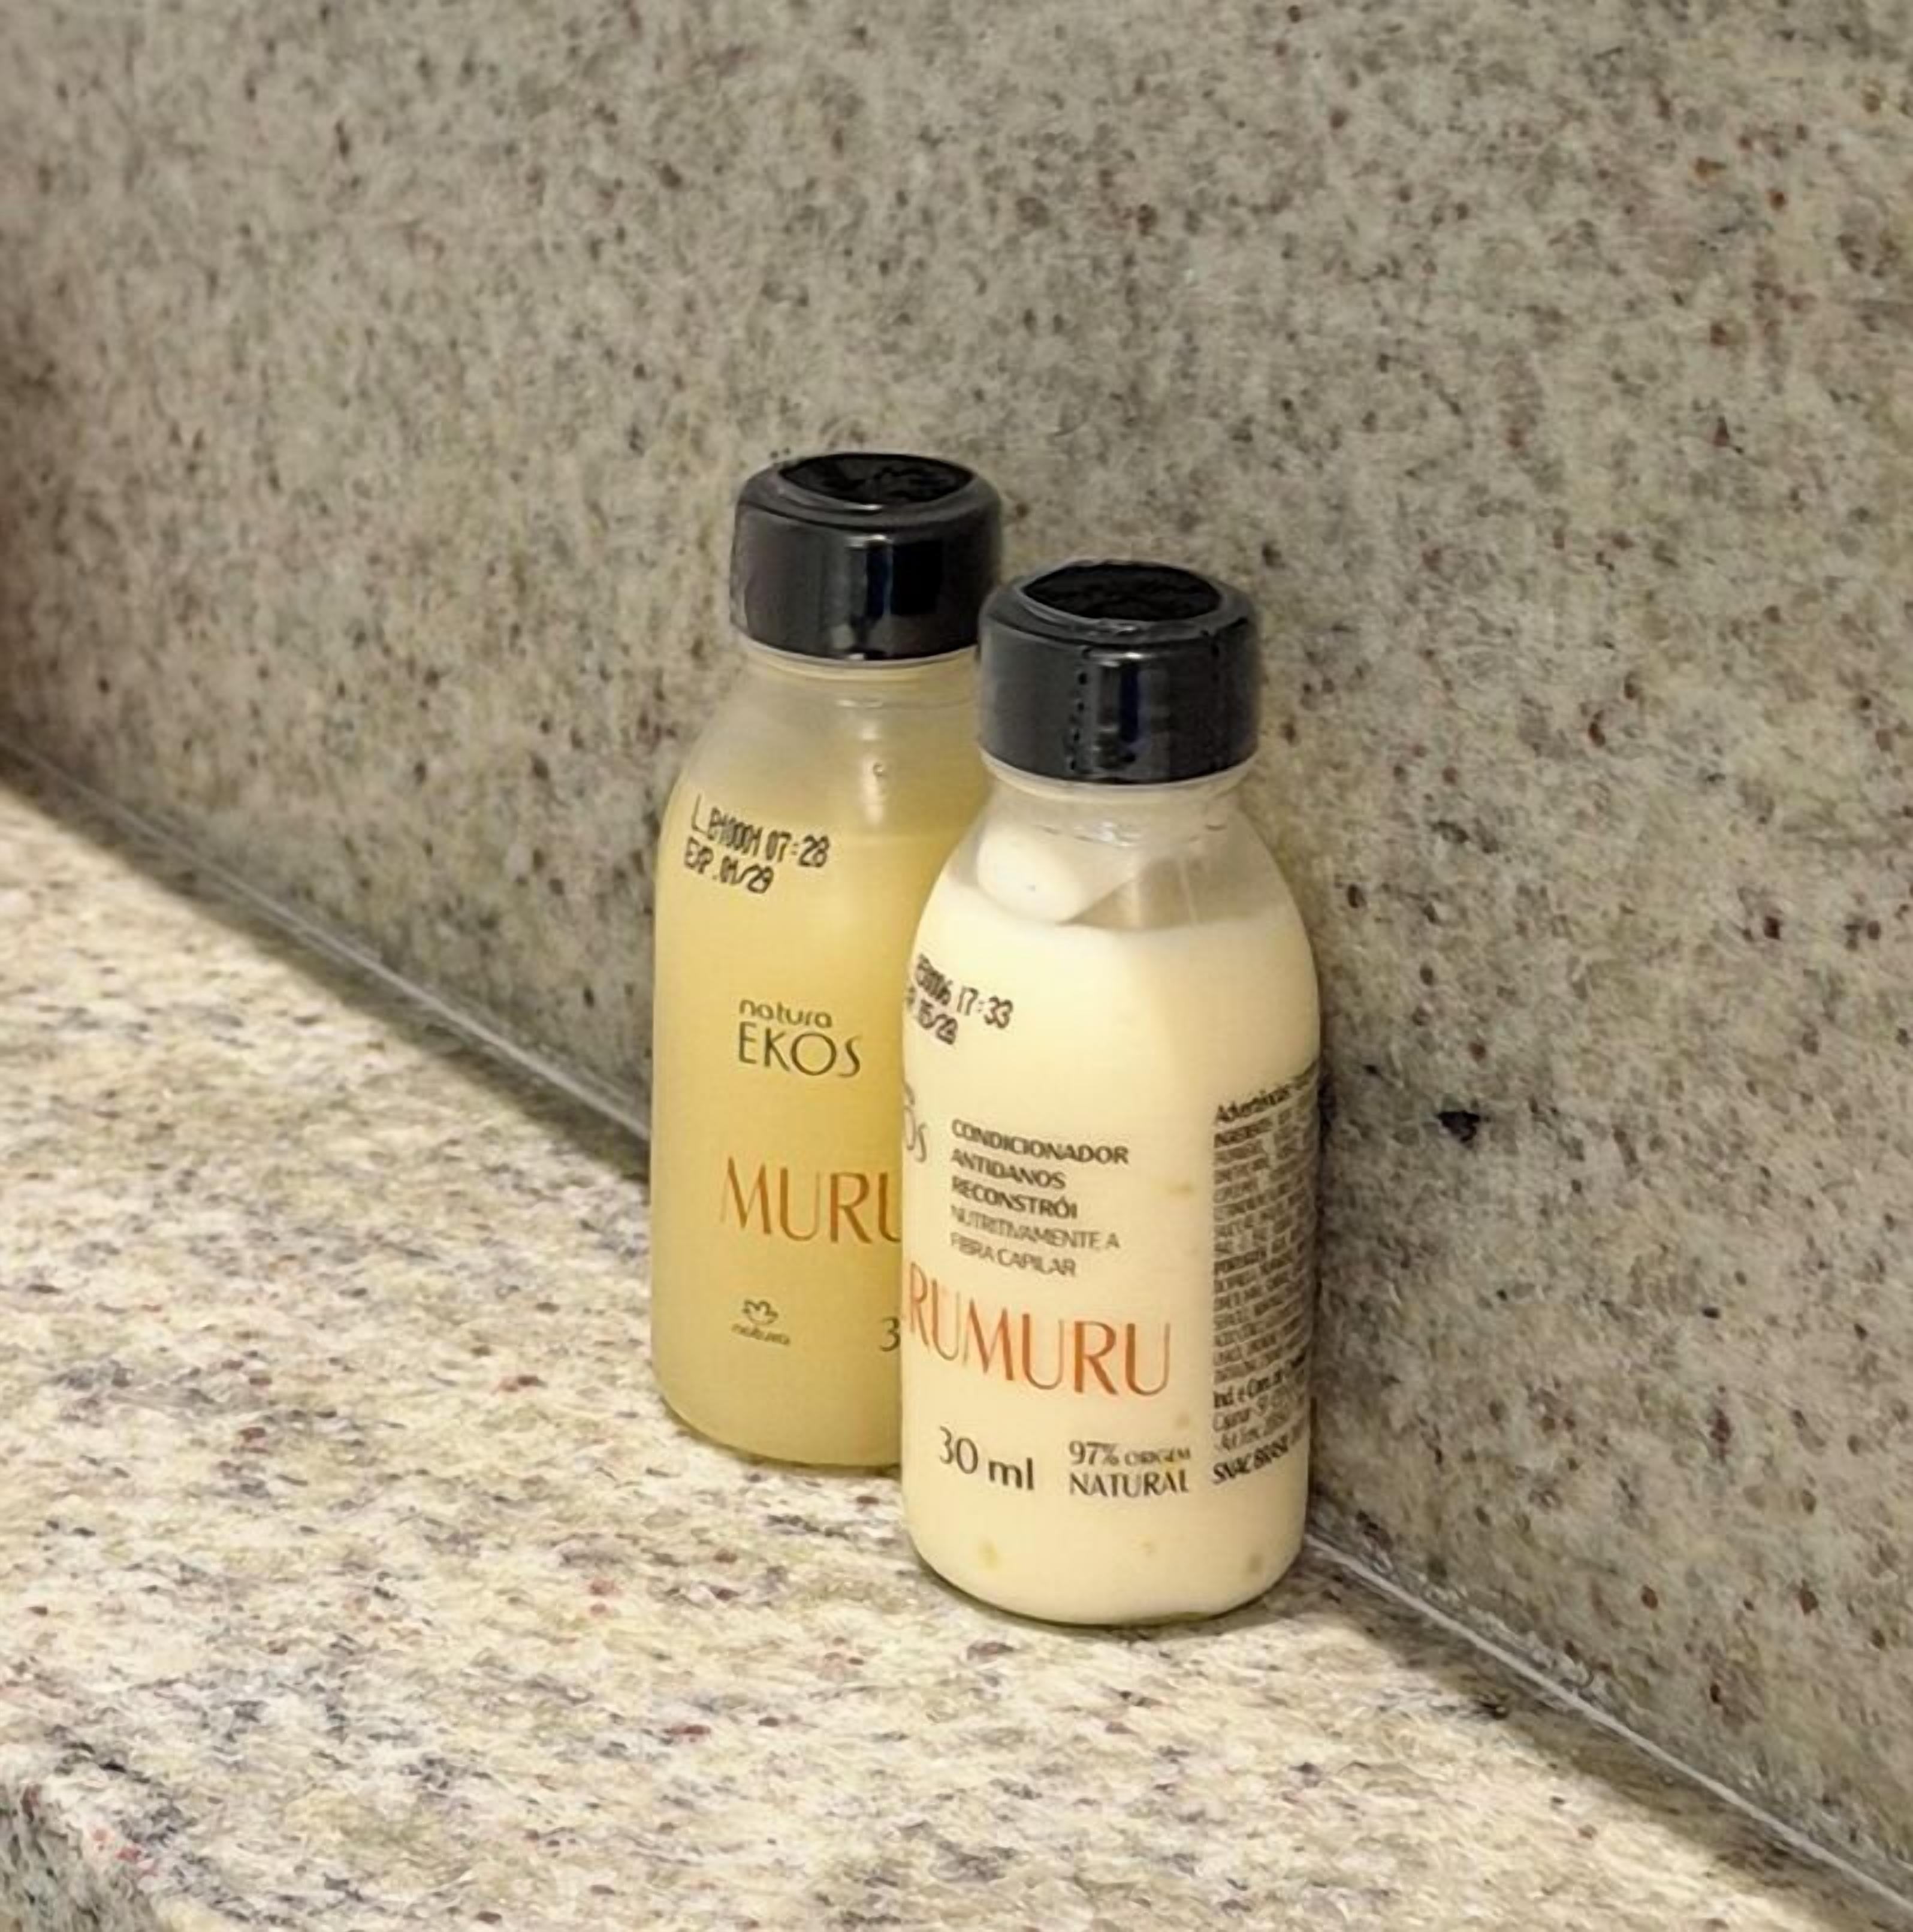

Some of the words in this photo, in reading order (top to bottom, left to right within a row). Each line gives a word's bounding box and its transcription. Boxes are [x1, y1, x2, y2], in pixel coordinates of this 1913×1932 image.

[739, 999, 833, 1028] natura
[738, 1021, 863, 1078] EKOS
[952, 1118, 1130, 1164] CONDICIONADOR
[951, 1148, 1066, 1190] ANTIDANOS
[951, 1175, 1078, 1219] RECONSTRÓI
[1105, 1232, 1120, 1249] A
[997, 1248, 1076, 1277] CAPILAR
[939, 1424, 979, 1474] 30
[988, 1457, 1035, 1490] ml
[1069, 1440, 1120, 1466] 97%
[1069, 1469, 1190, 1499] NATURAL
